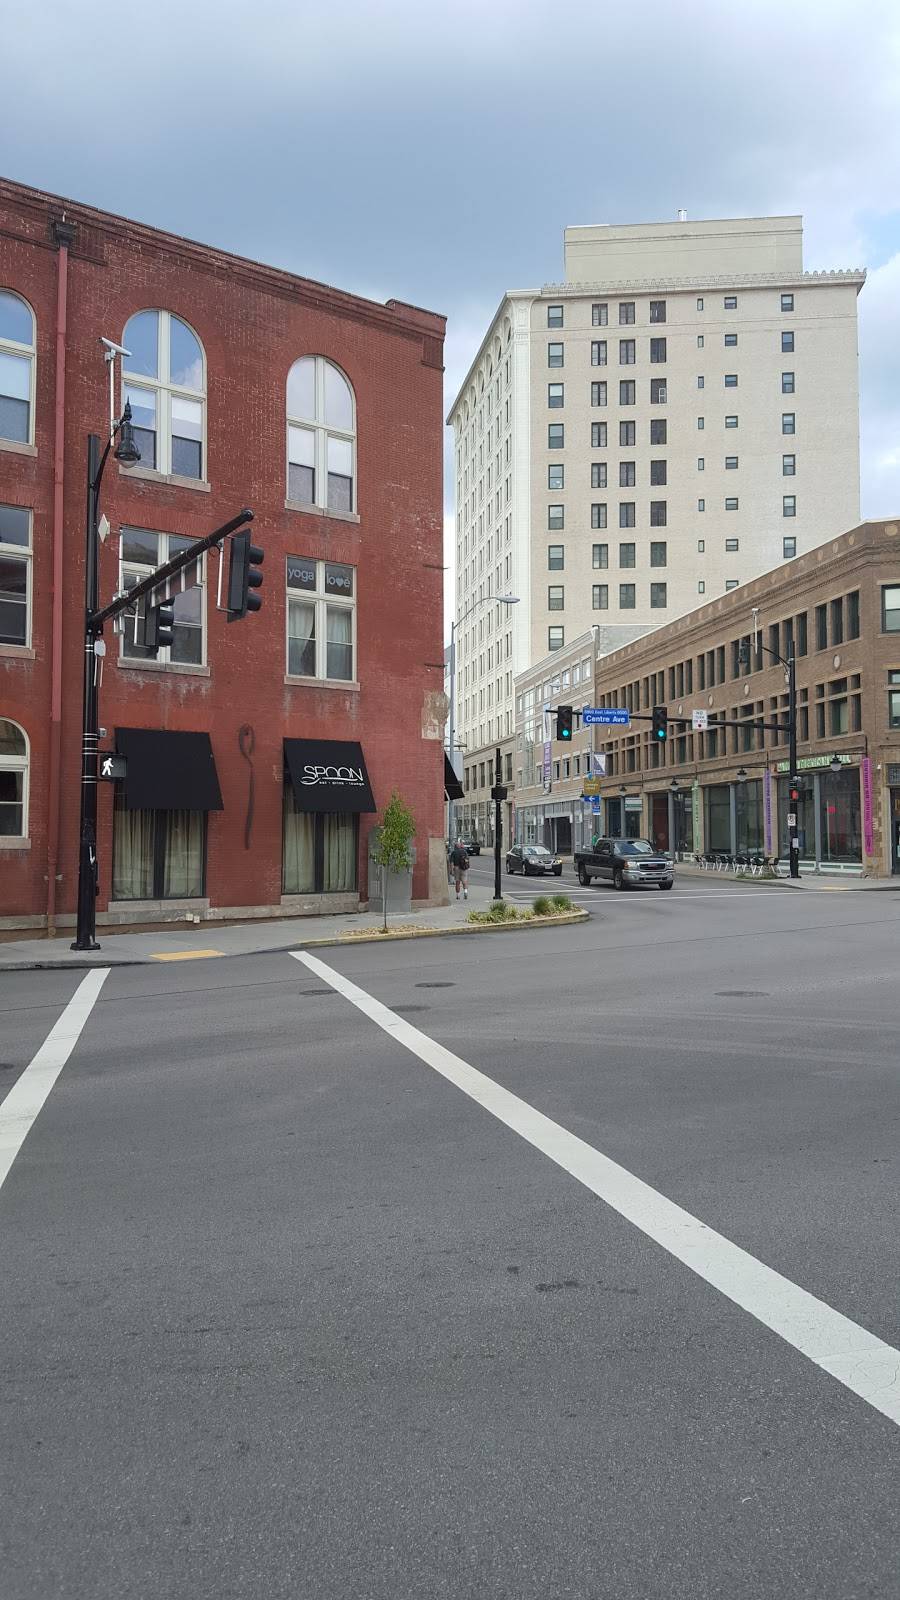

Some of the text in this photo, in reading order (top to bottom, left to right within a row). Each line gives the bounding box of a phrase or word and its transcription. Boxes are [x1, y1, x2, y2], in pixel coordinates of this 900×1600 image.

[288, 568, 314, 582] yoga
[612, 715, 626, 723] Ave
[301, 766, 363, 785] SPOON
